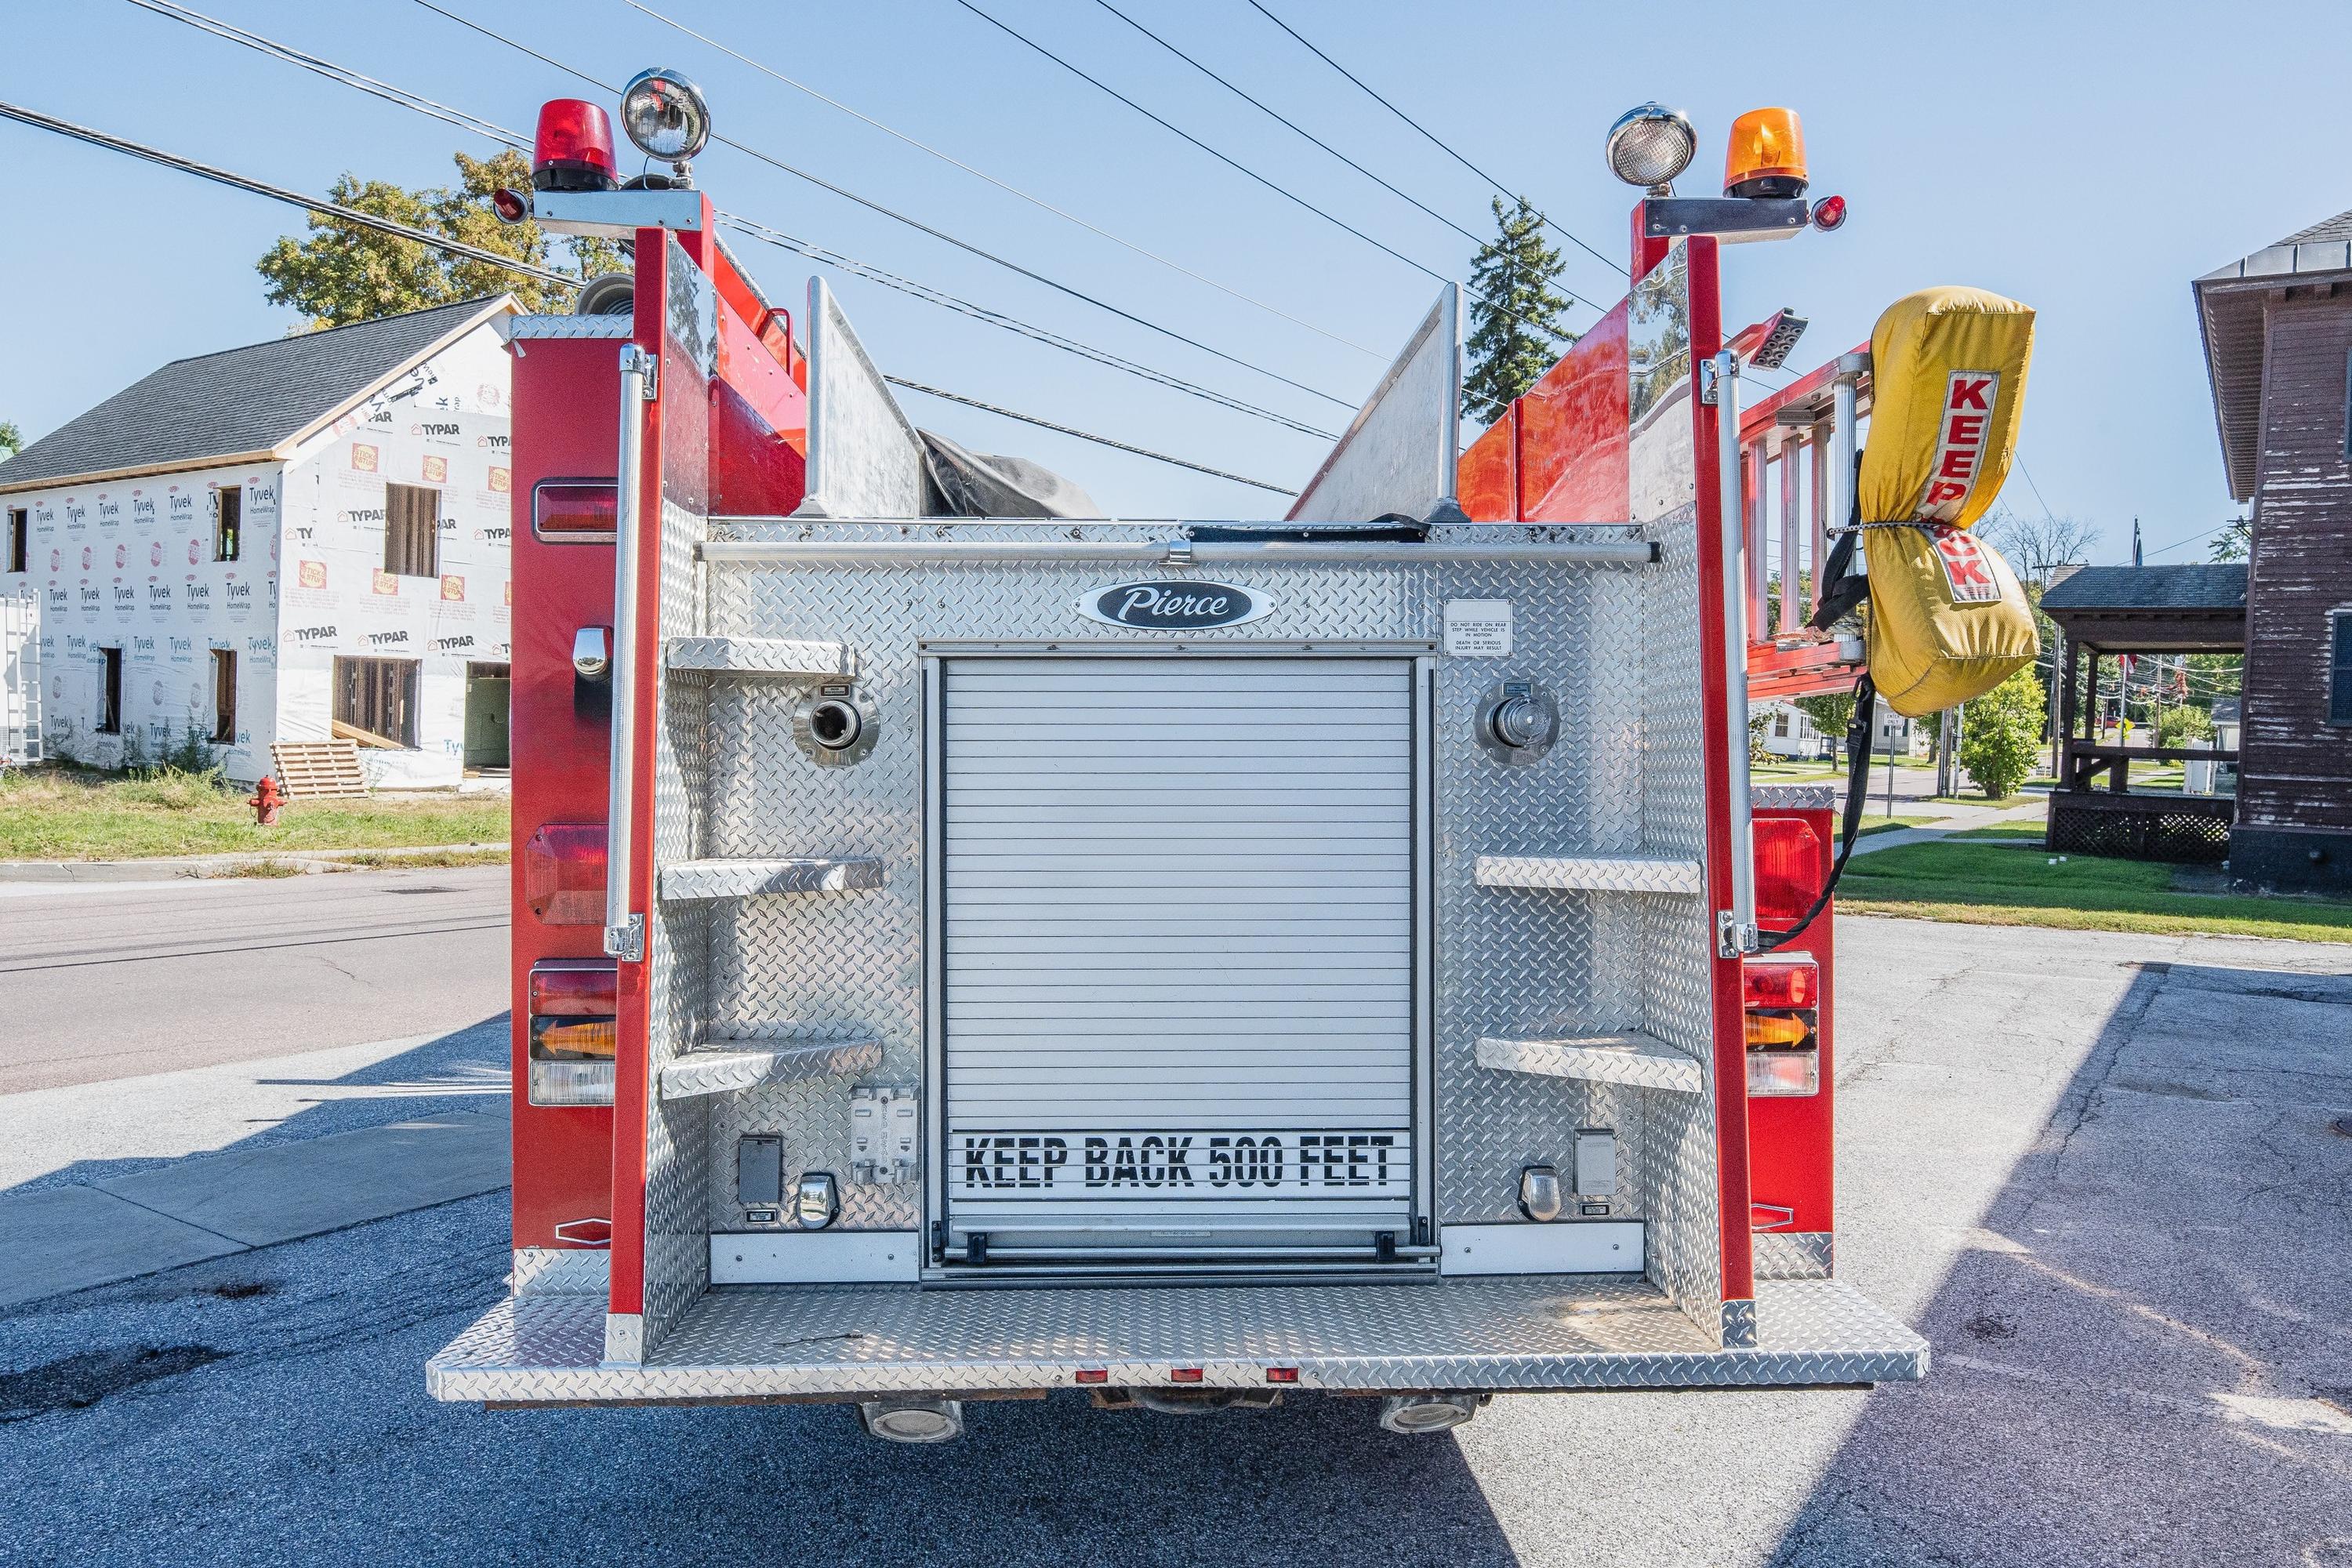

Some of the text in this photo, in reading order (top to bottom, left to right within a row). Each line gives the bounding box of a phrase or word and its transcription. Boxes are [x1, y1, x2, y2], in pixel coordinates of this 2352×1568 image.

[422, 423, 460, 435] TYPAR
[1926, 379, 1993, 506] KEEP
[170, 494, 192, 512] Tyvek
[249, 485, 274, 505] Tyvek
[99, 502, 119, 518] Tyvek
[133, 497, 154, 515] Tyvek
[249, 506, 275, 514] HomeWrap
[36, 508, 54, 524] Tyvek
[49, 588, 67, 604] Tyvek
[81, 587, 100, 603] Tyvek
[114, 586, 134, 602] Tyvek
[149, 585, 171, 601] Tyvek
[187, 583, 209, 601] Tyvek
[226, 582, 250, 600] Tyvek
[1117, 587, 1229, 621] Pierce
[41, 635, 54, 648] vek
[295, 626, 338, 641] TYPAR
[368, 630, 408, 645] TYPAR
[67, 635, 86, 651] Tyvek
[89, 641, 100, 652] vek
[134, 636, 154, 652] Tyvek
[169, 637, 192, 653] Tyvek
[437, 635, 474, 650] TYPAR
[236, 729, 251, 744] vek
[965, 1135, 1393, 1189] KEEP BACK 500 FEET
